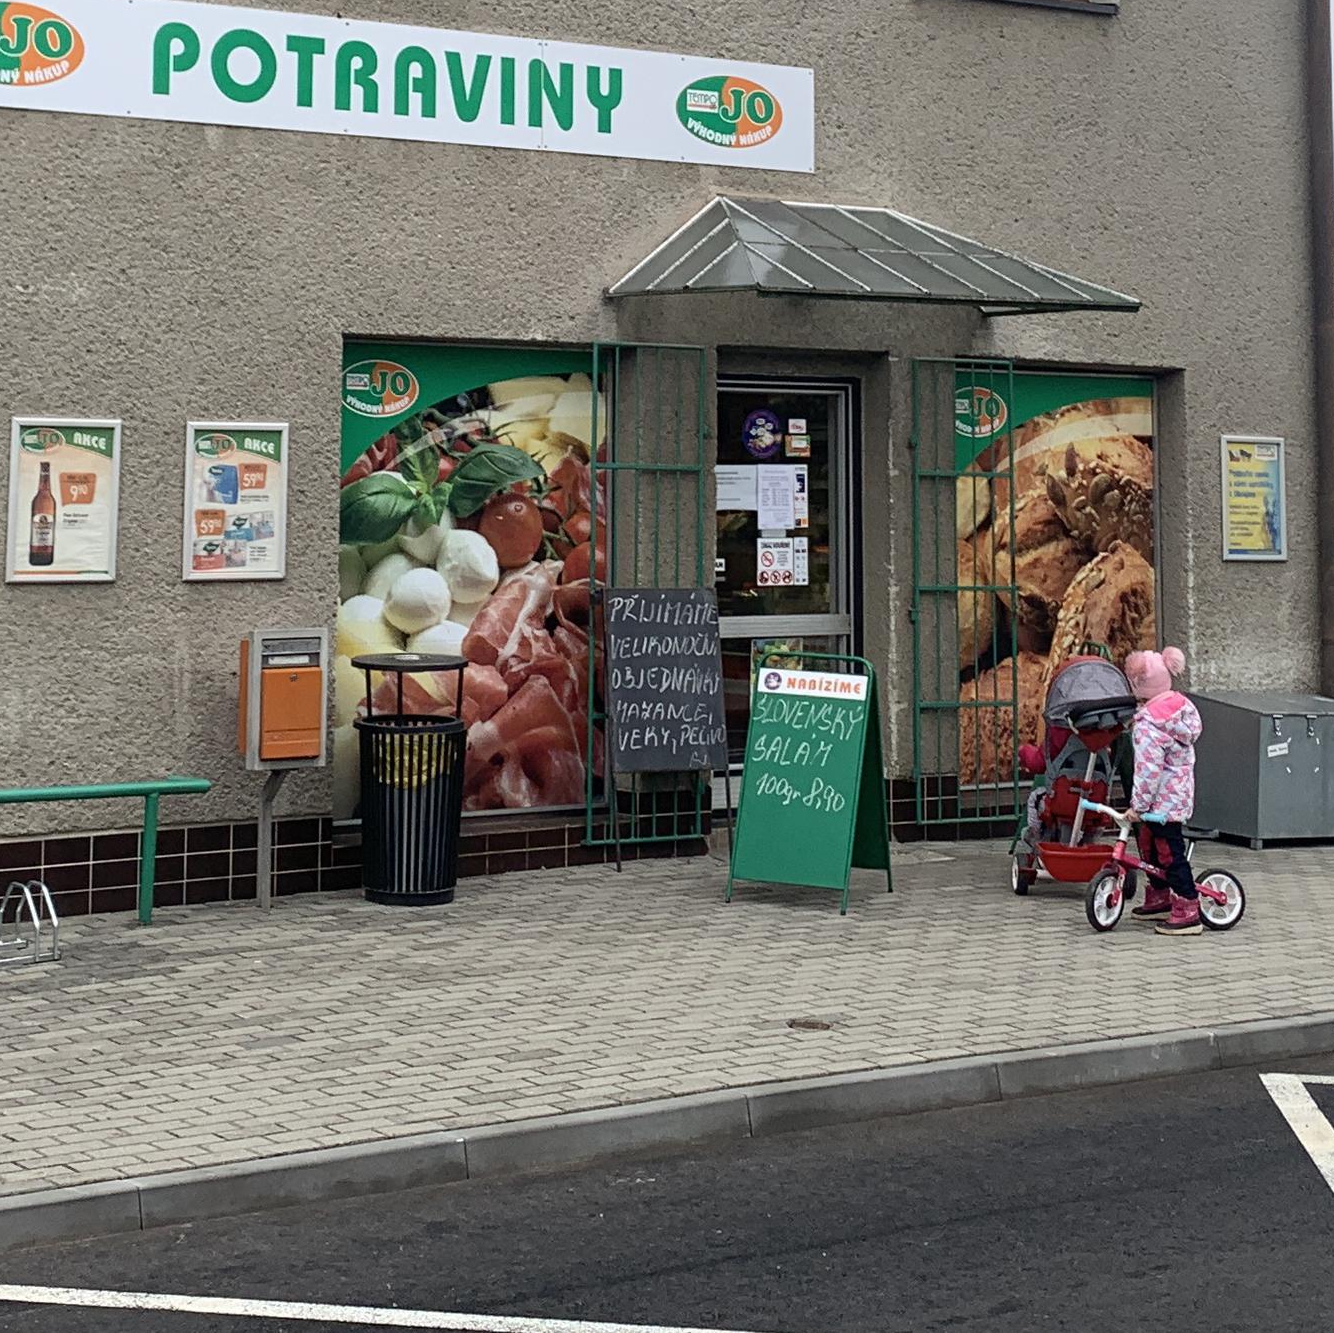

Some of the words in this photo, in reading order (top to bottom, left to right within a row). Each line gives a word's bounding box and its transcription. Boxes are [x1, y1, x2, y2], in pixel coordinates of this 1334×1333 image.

[24, 60, 70, 84] NÁKUP
[152, 21, 623, 134] POTRAVINY
[719, 87, 775, 126] JO
[369, 369, 412, 398] JO
[73, 431, 107, 450] AKCE
[243, 437, 276, 455] AKCE
[608, 592, 718, 626] PŘIJÍMÁME
[786, 677, 862, 694] NABÍZÍME
[753, 694, 864, 740] SLOVENSKÝ
